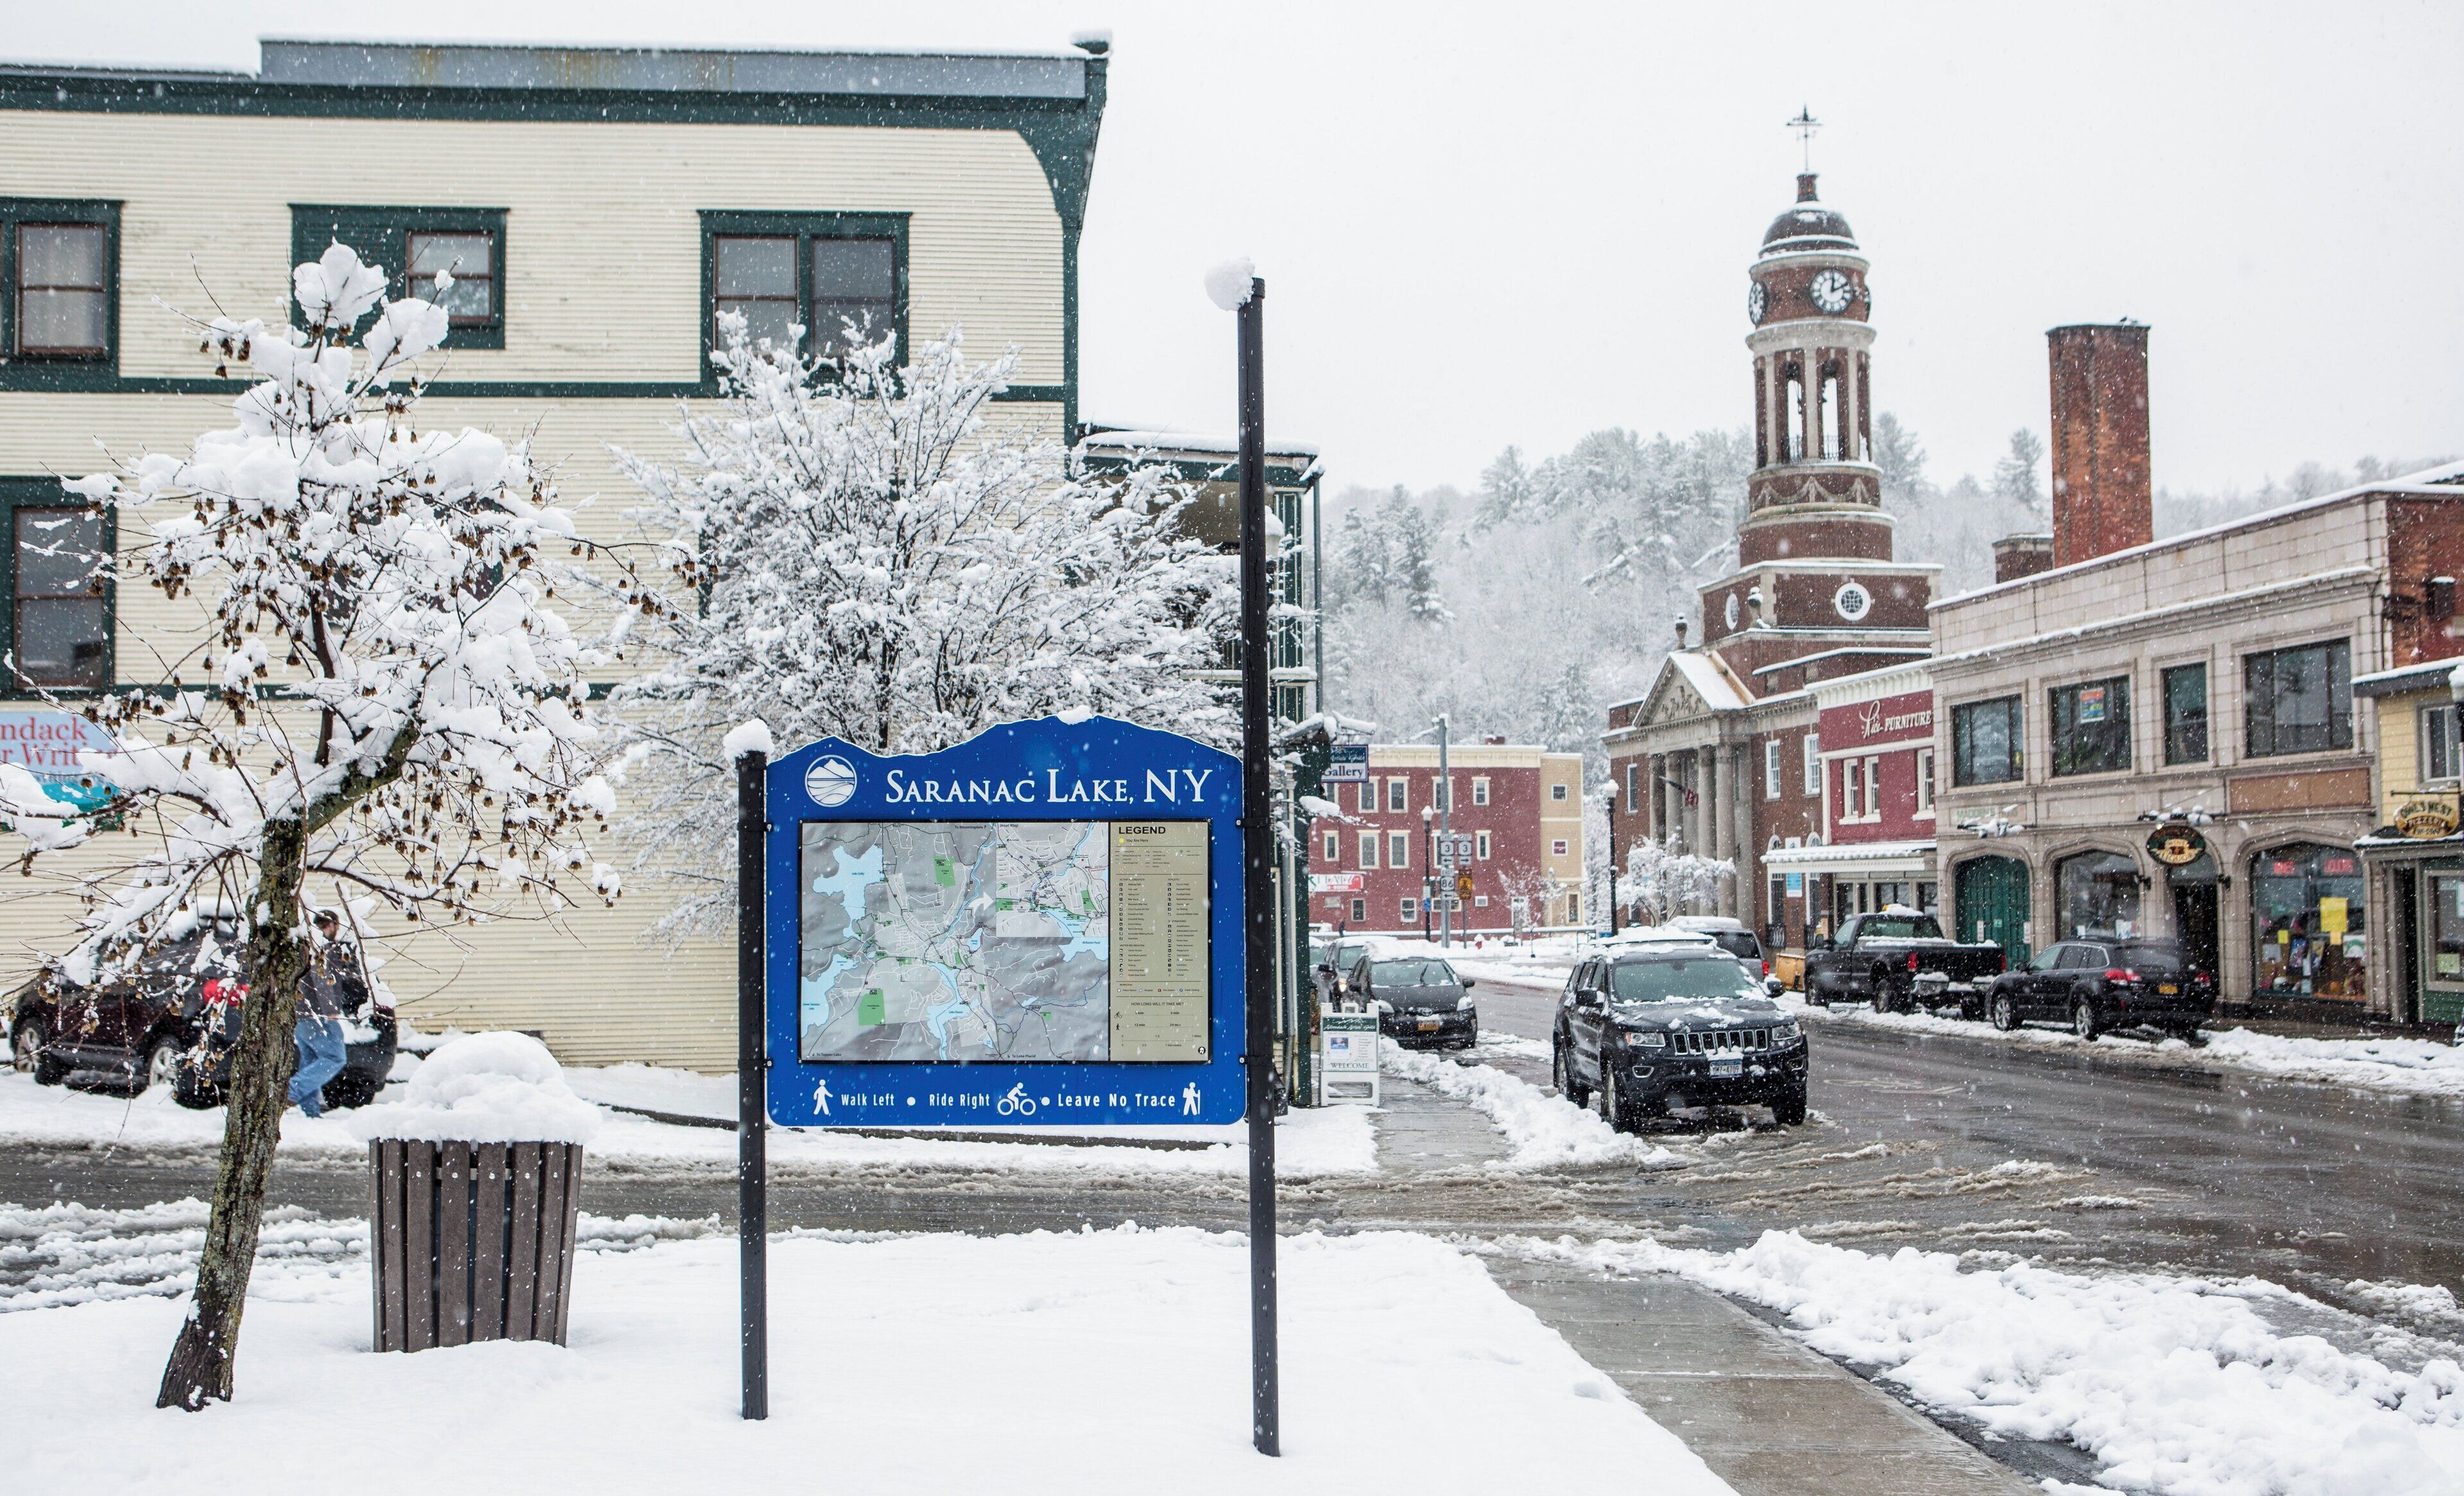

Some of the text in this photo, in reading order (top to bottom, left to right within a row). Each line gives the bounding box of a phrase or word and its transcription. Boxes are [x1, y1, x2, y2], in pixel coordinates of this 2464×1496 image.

[1885, 710, 1932, 732] FURNITURE
[21, 742, 119, 766] Writ
[1324, 766, 1363, 778] Gallery
[886, 769, 1213, 805] SARANAC LAKE, NY
[2428, 802, 2452, 816] NEST
[1118, 826, 1166, 834] LEGEND
[1442, 879, 1453, 888] 86
[841, 1094, 894, 1106] Walk Left
[929, 1094, 990, 1108] Ride Right
[1057, 1093, 1176, 1107] Leave No Trace
